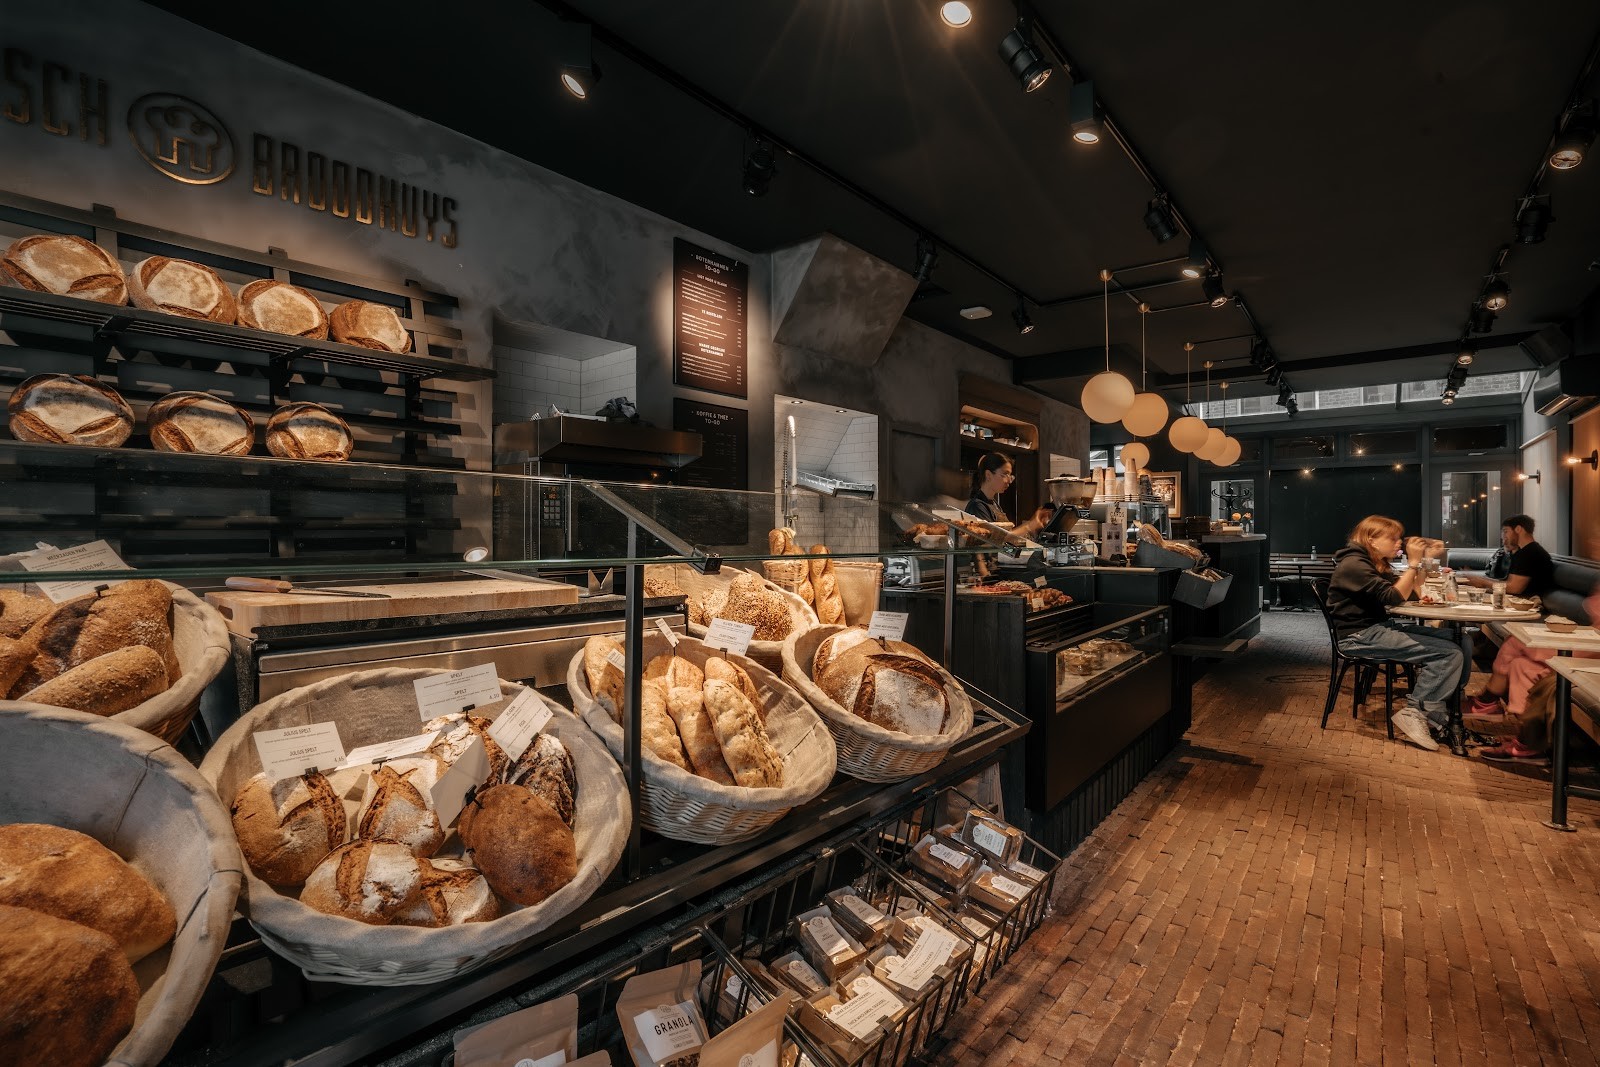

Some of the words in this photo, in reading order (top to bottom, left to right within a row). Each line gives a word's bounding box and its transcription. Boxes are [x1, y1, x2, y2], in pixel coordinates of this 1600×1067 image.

[253, 131, 458, 249] BROODHUYS
[695, 254, 729, 271] BOTERHAMMEN
[696, 410, 712, 418] KOFFIE
[654, 1016, 694, 1035] GRANOLA
